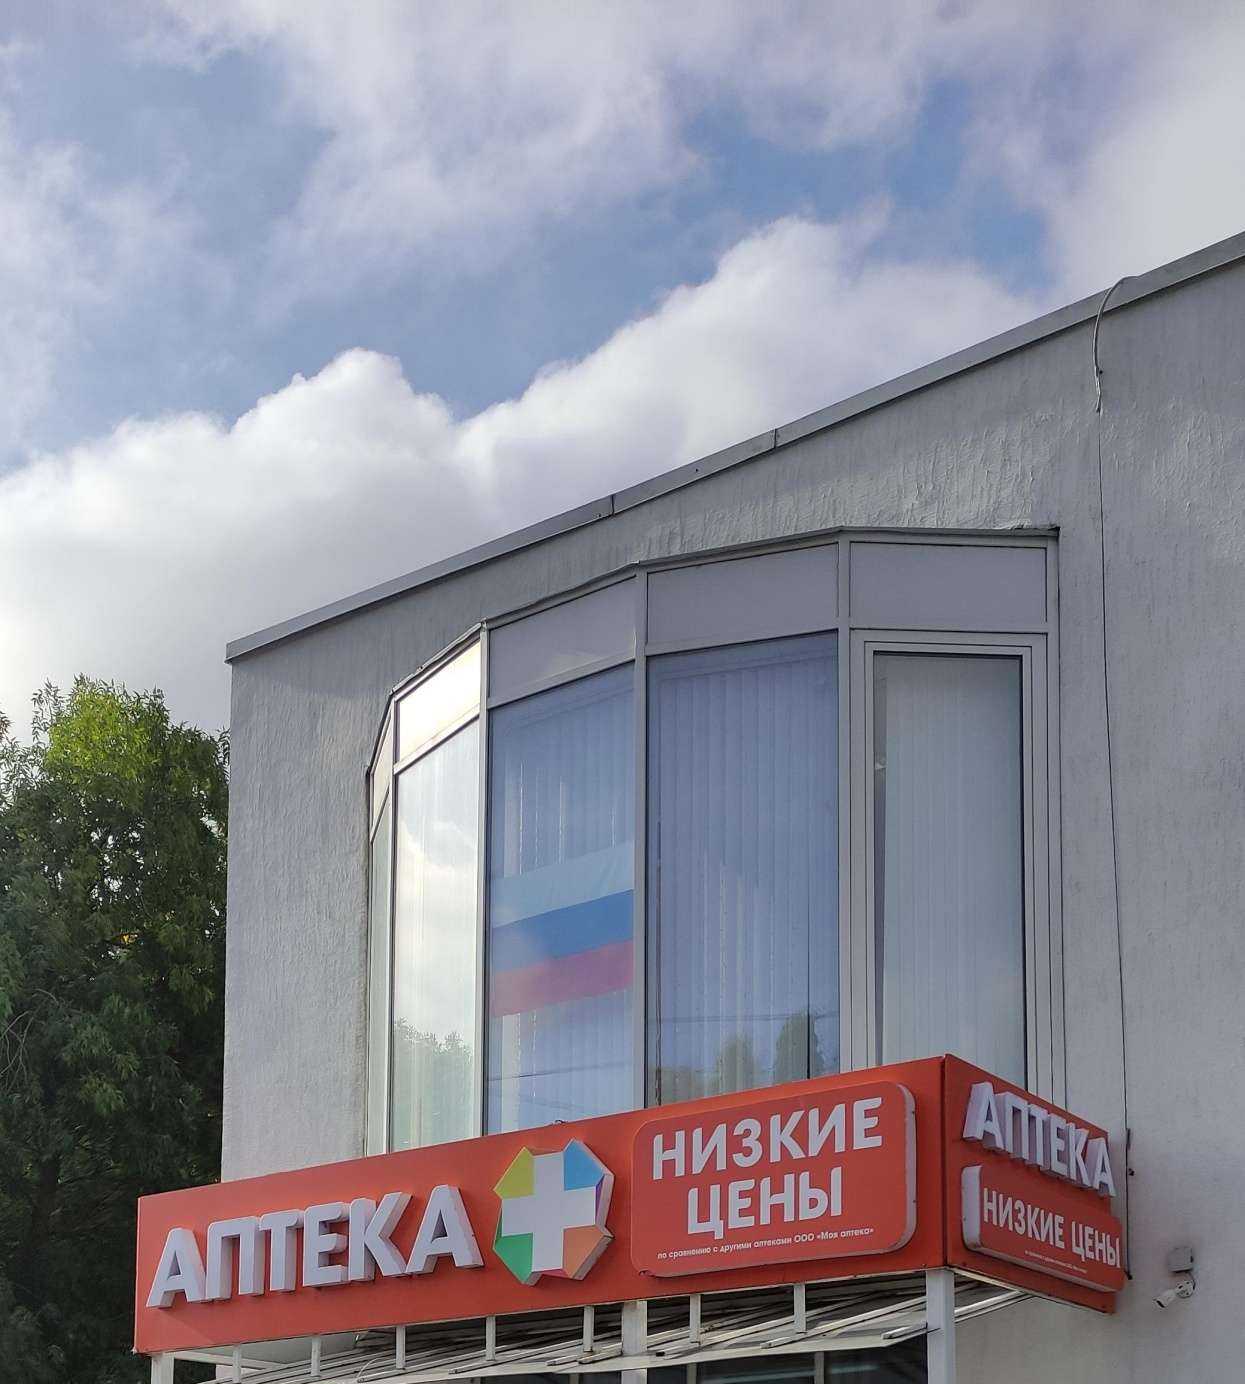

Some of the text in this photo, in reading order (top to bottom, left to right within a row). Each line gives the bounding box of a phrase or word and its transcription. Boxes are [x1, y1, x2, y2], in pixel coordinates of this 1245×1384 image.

[652, 1096, 882, 1180] НИЗКИЕ
[963, 1082, 1117, 1197] АПТЕКА
[687, 1166, 842, 1239] ЦЕНЫ
[983, 1187, 1065, 1249] НИЗКИЕ
[1072, 1220, 1121, 1268] ЦЕНЫ
[146, 1184, 484, 1308] АПТЕКА
[668, 1247, 711, 1260] сравнению
[720, 1243, 752, 1253] другими
[754, 1237, 792, 1248] аптеками
[793, 1233, 815, 1243] ООО
